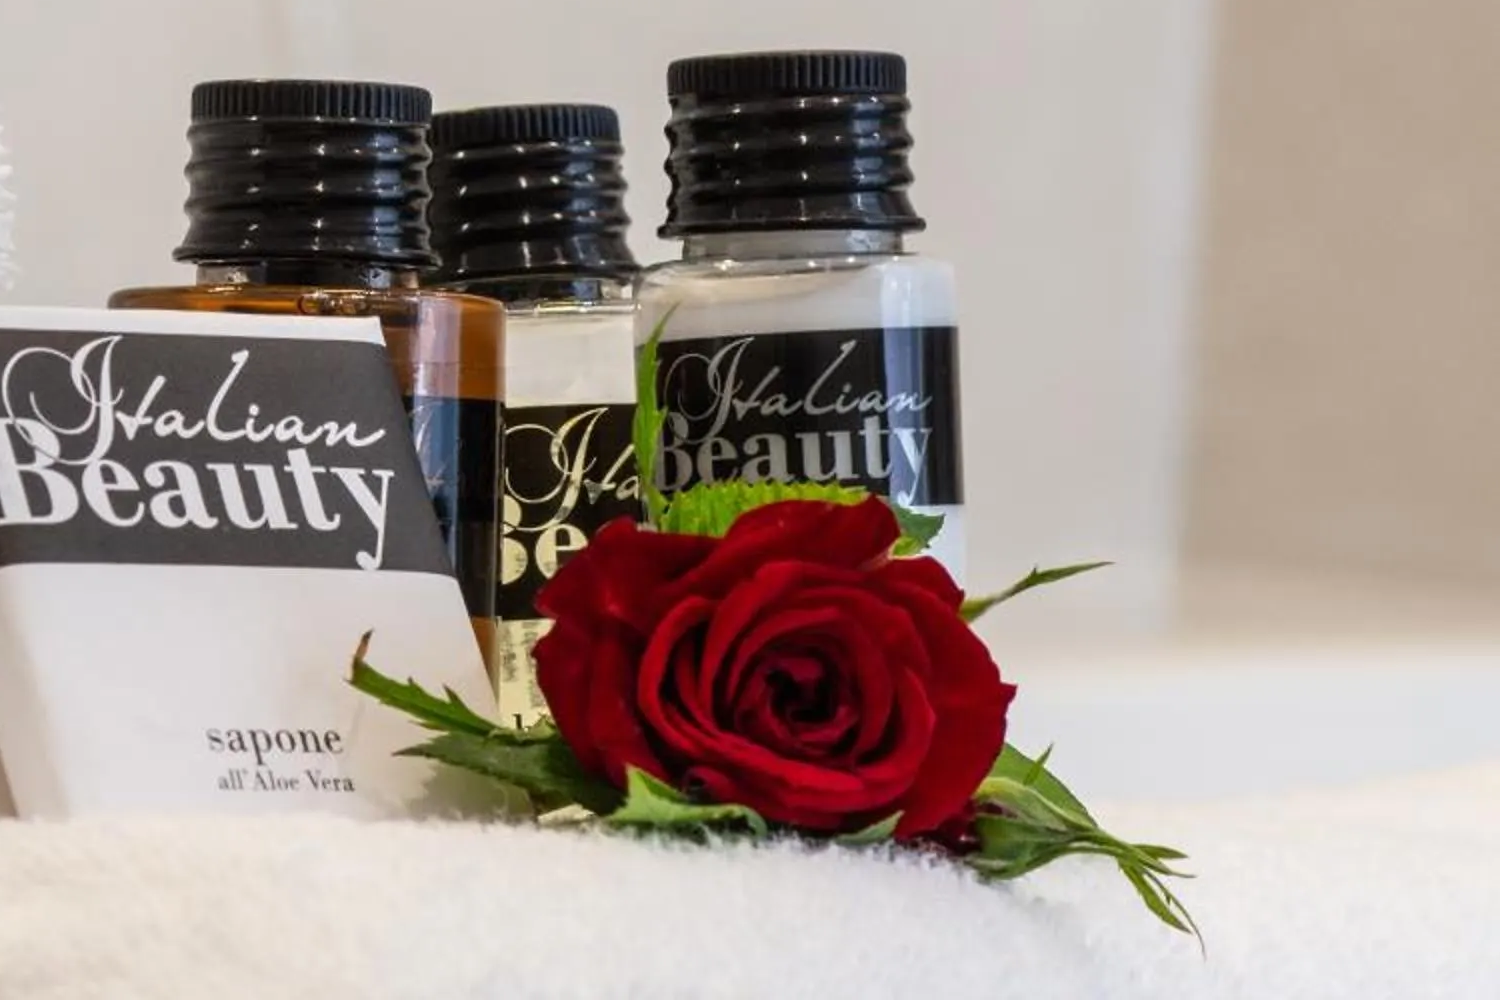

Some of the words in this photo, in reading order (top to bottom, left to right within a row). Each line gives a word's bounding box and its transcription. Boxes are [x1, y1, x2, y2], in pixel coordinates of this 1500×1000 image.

[2, 335, 386, 465] Italian
[663, 336, 933, 445] Italian
[206, 727, 344, 766] sapone
[304, 768, 356, 792] Vera
